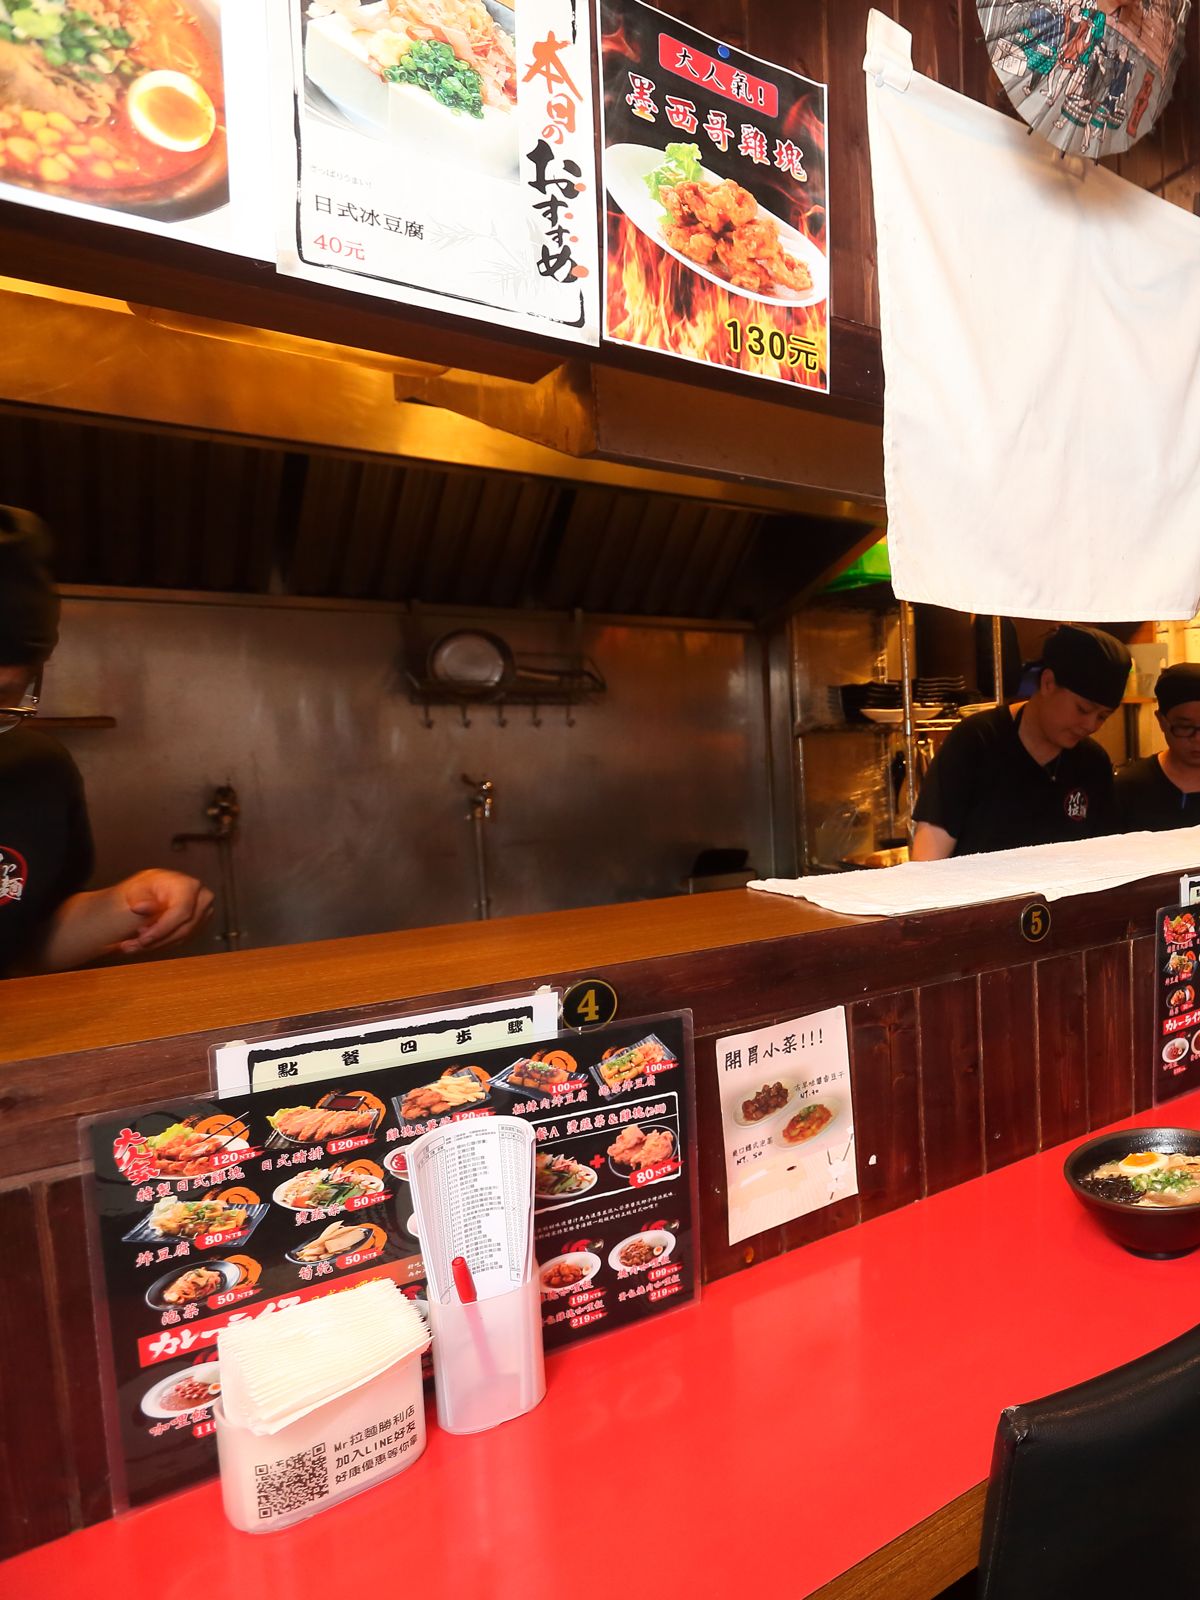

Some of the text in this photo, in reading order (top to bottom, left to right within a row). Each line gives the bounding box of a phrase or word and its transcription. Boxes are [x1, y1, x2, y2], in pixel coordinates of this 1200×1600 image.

[675, 47, 764, 106] 大人氣!
[625, 71, 807, 182] 墨西哥雞塊
[315, 194, 424, 240] 日式冰豆腐
[313, 234, 366, 260] 40元
[725, 318, 819, 372] 130元
[1031, 910, 1042, 935] 5
[577, 989, 600, 1021] 4
